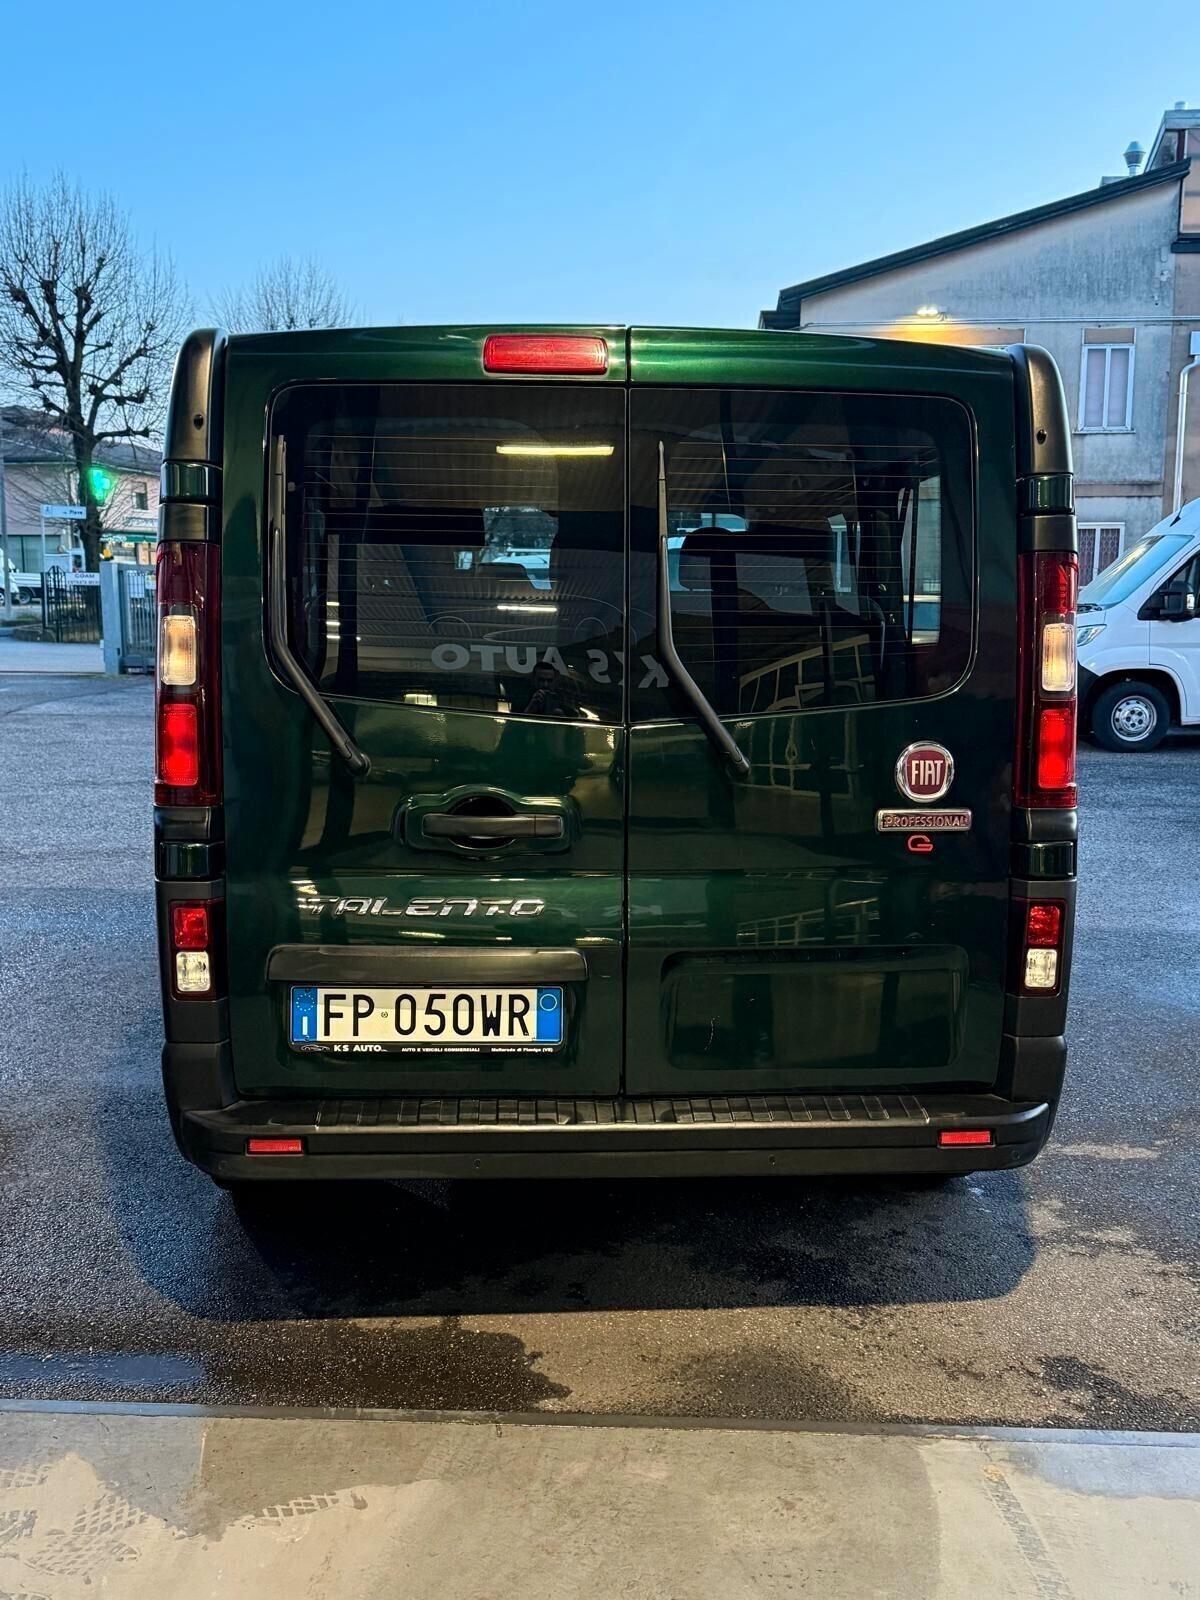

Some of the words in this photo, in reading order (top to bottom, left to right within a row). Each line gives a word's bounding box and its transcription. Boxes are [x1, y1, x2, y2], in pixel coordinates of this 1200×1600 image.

[911, 760, 944, 786] FIAT
[883, 813, 968, 828] PROFESSIONAL
[304, 896, 546, 917] TALENTO
[323, 994, 375, 1037] FP
[394, 993, 531, 1038] 050WR
[352, 1044, 382, 1052] AUTO
